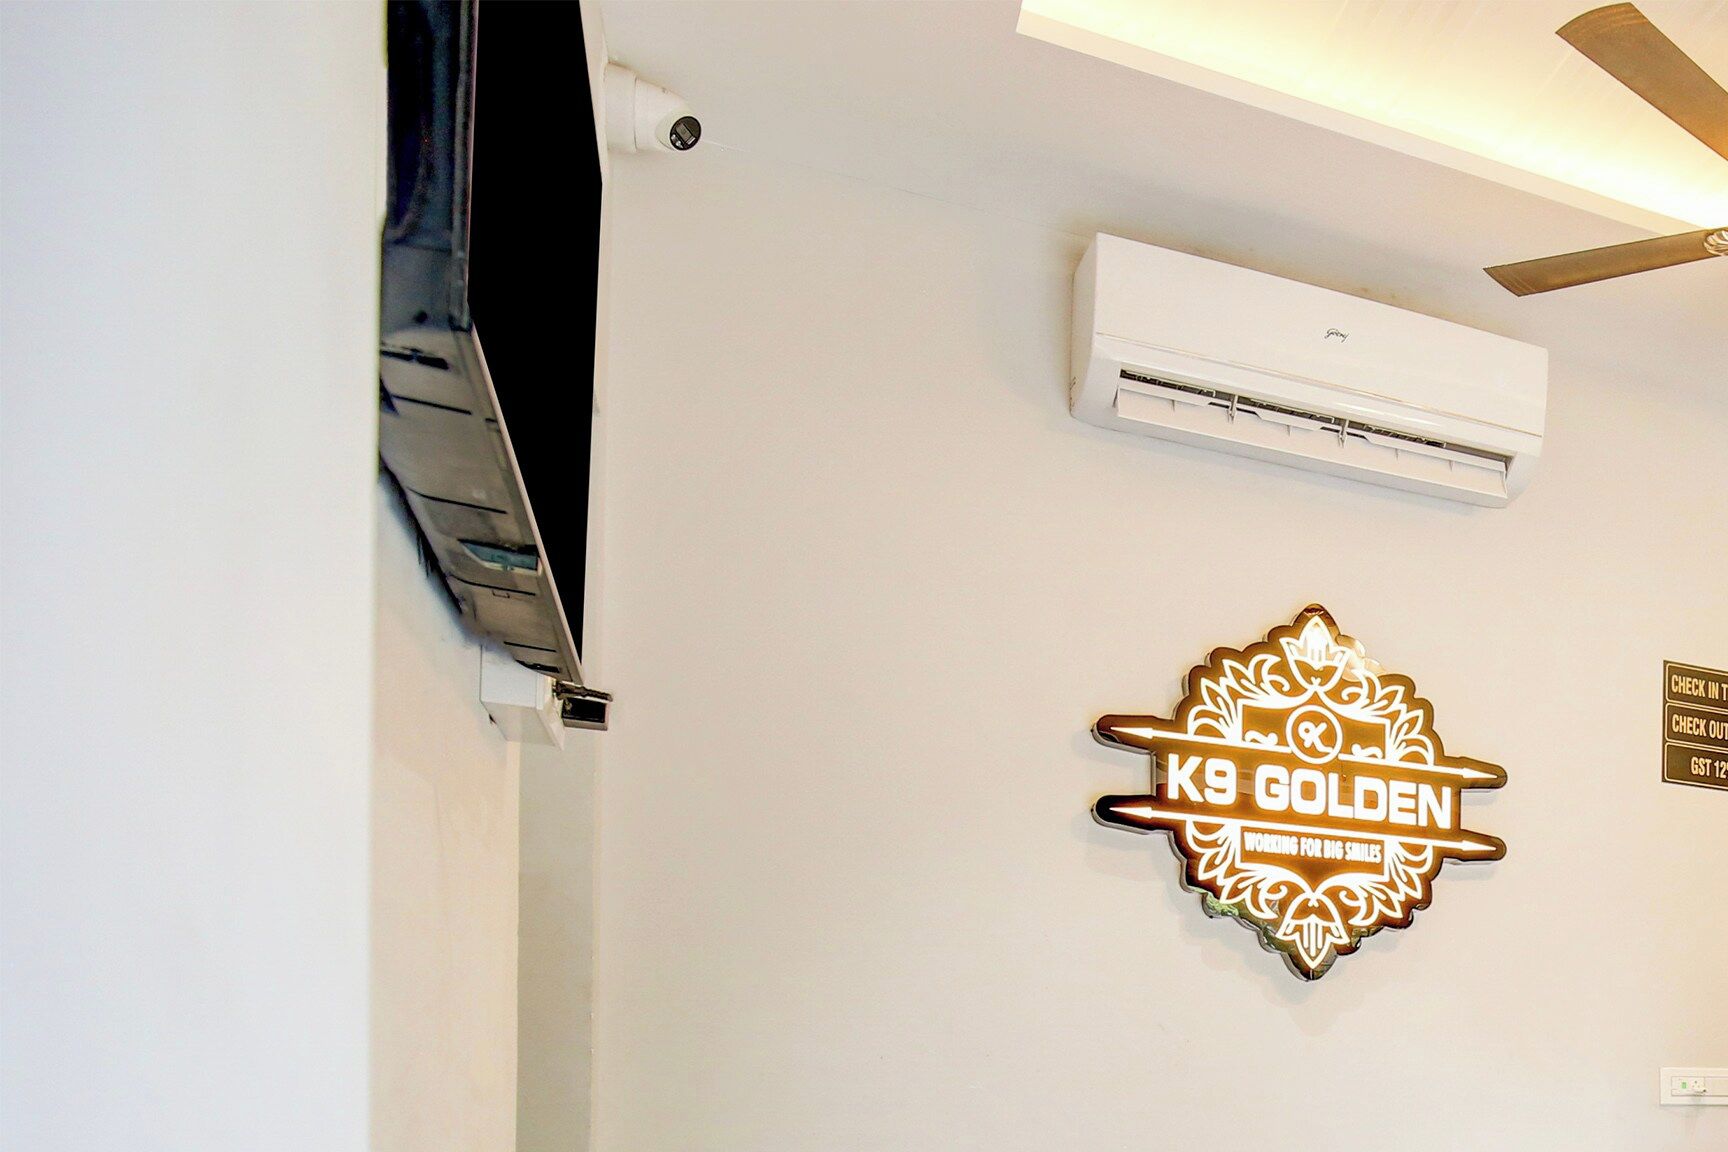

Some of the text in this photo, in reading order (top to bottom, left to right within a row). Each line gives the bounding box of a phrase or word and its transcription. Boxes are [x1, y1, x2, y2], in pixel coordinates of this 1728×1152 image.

[1671, 674, 1705, 697] CHECK
[1708, 681, 1719, 700] IN
[1671, 714, 1707, 737] CHECK
[1691, 756, 1712, 777] GST
[1167, 753, 1452, 830] K9 GOLDEN
[1244, 831, 1382, 864] WORKING FOR BIG SMILES
